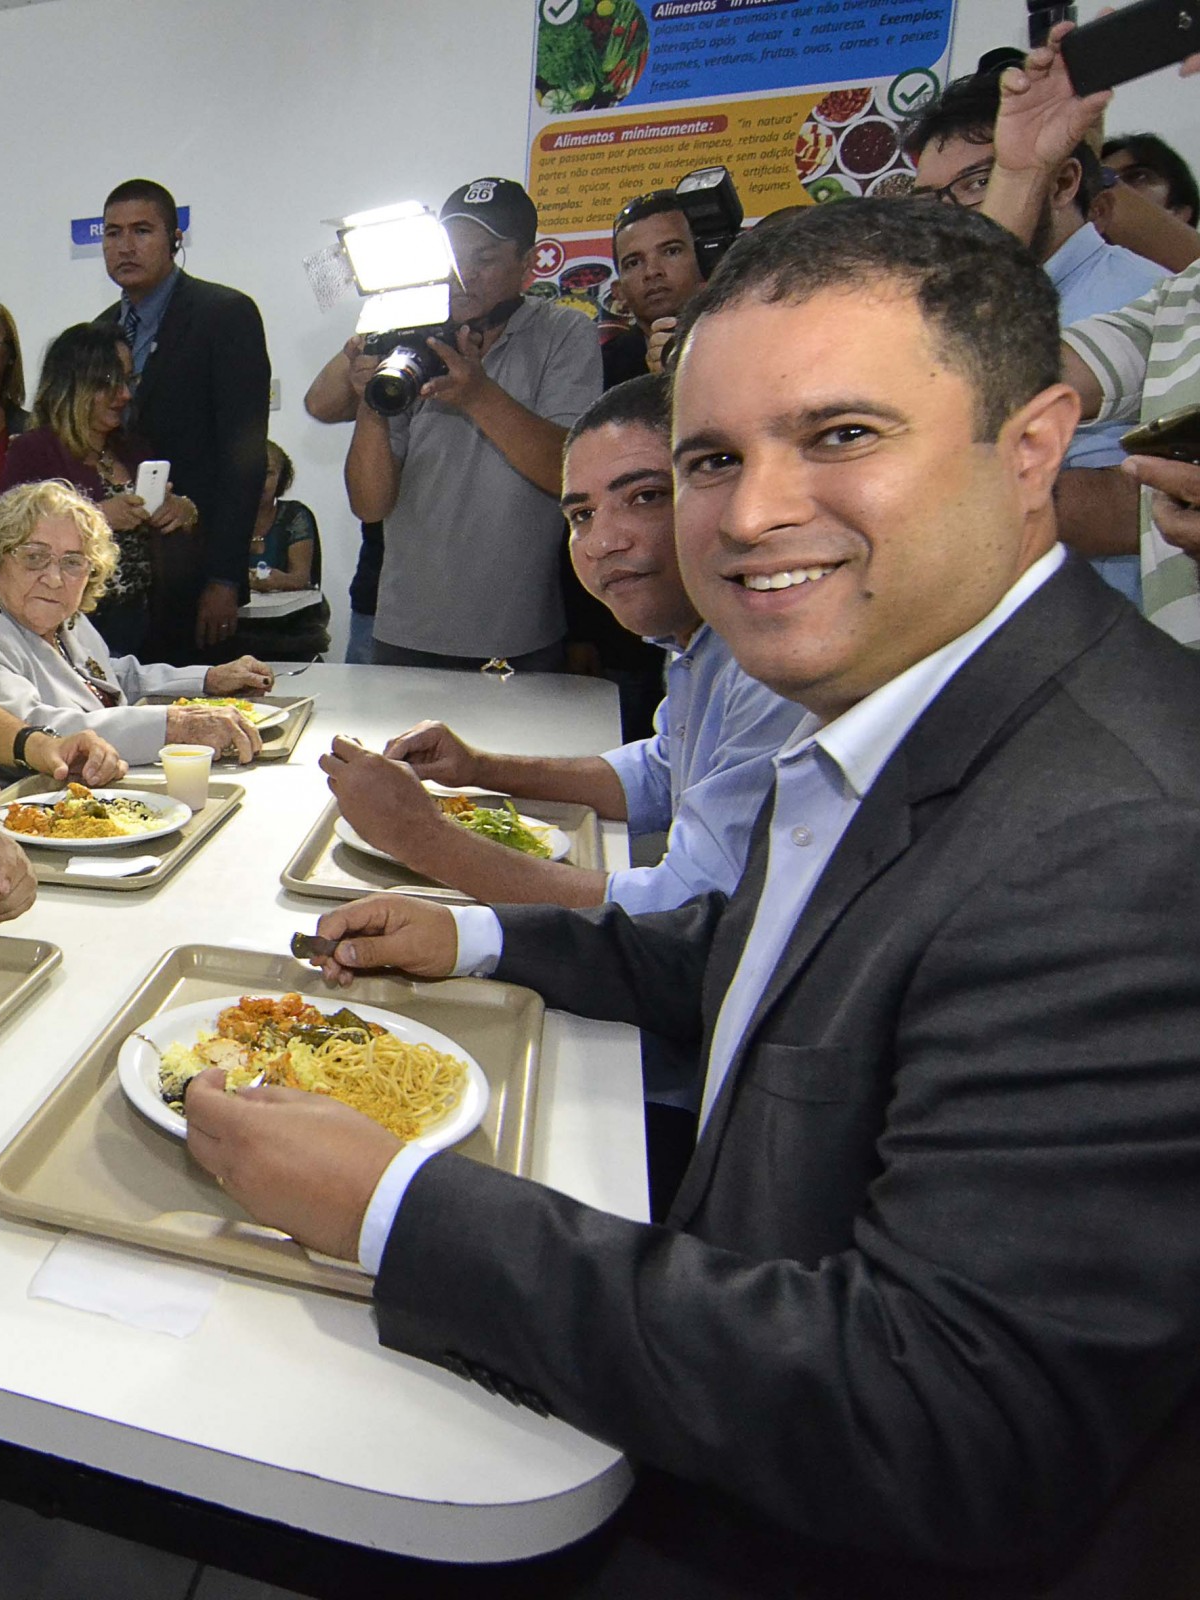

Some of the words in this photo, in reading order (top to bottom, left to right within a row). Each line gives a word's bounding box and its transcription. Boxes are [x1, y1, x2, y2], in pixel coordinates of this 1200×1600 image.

[655, 22, 695, 36] plantas
[698, 20, 712, 29] ou
[715, 17, 730, 28] de
[791, 7, 813, 19] que
[900, 29, 940, 44] peixes
[540, 157, 556, 166] que
[559, 151, 604, 165] passaram
[608, 149, 624, 159] por
[627, 144, 674, 157] processos
[678, 141, 689, 151] de
[739, 131, 778, 144] retirada
[783, 130, 796, 140] de
[554, 132, 615, 148] Alimentos
[538, 169, 566, 181] partes
[570, 167, 588, 177] não
[648, 161, 660, 170] ou
[727, 154, 733, 162] e
[735, 151, 756, 162] sem
[760, 147, 794, 159] adição
[467, 188, 491, 200] 66
[537, 186, 549, 196] de
[650, 177, 664, 185] ou
[537, 199, 583, 212] Exemplos:
[592, 196, 612, 206] leite
[748, 181, 791, 194] legumes
[572, 215, 585, 224] ou
